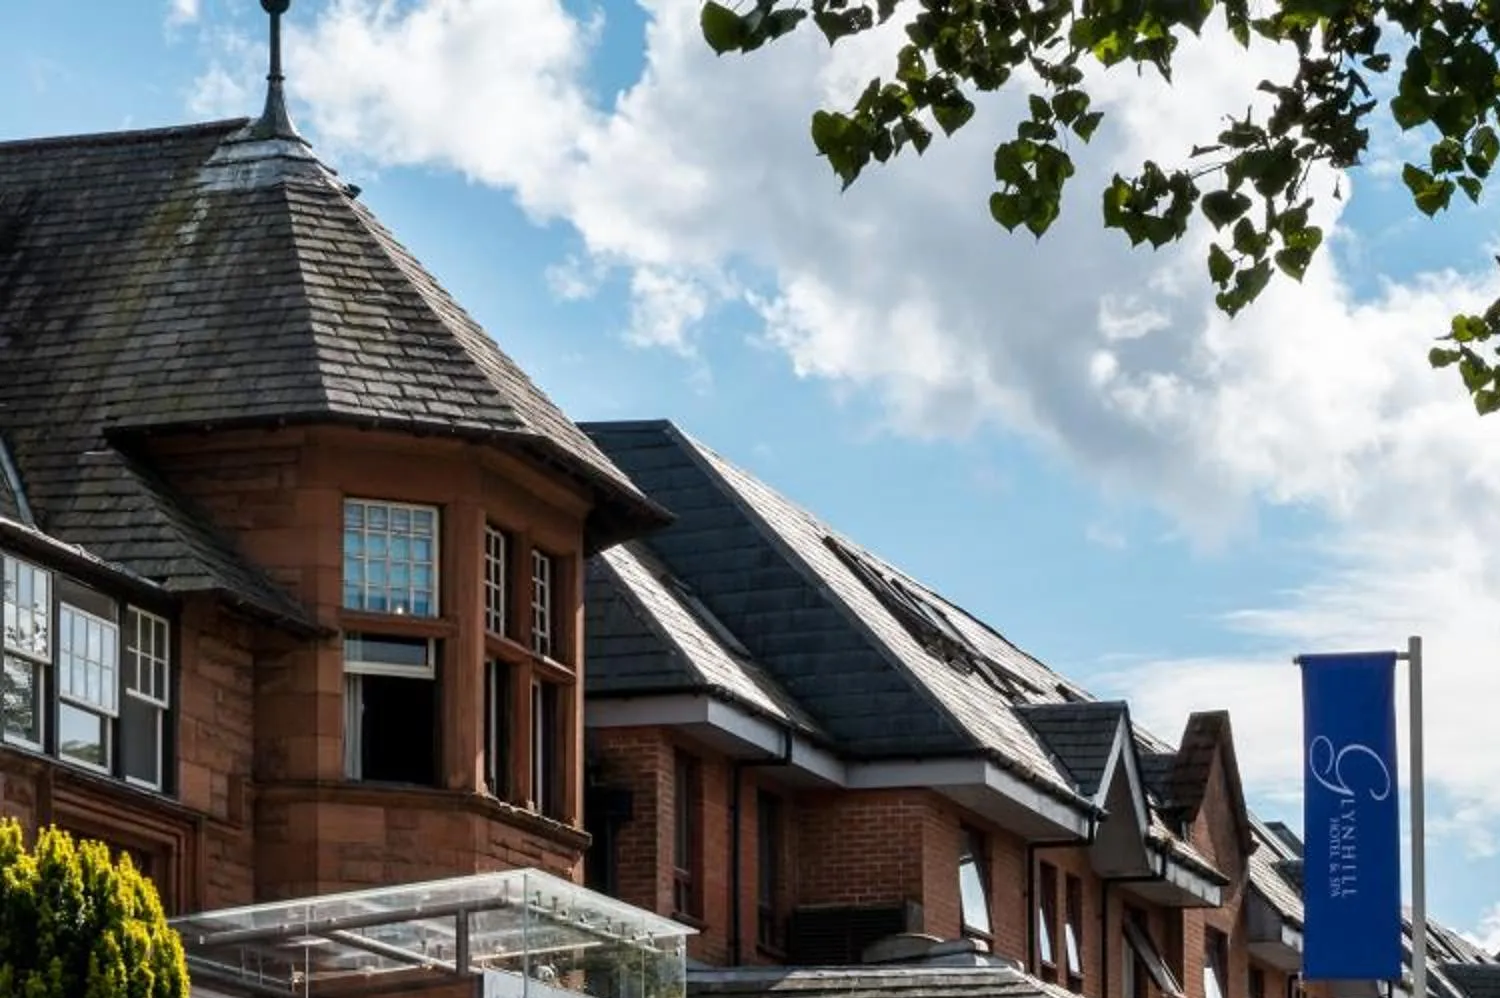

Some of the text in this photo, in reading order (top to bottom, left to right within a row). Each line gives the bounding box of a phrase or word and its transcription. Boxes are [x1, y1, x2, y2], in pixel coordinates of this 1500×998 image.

[1329, 817, 1342, 897] HOTEL & SPA
